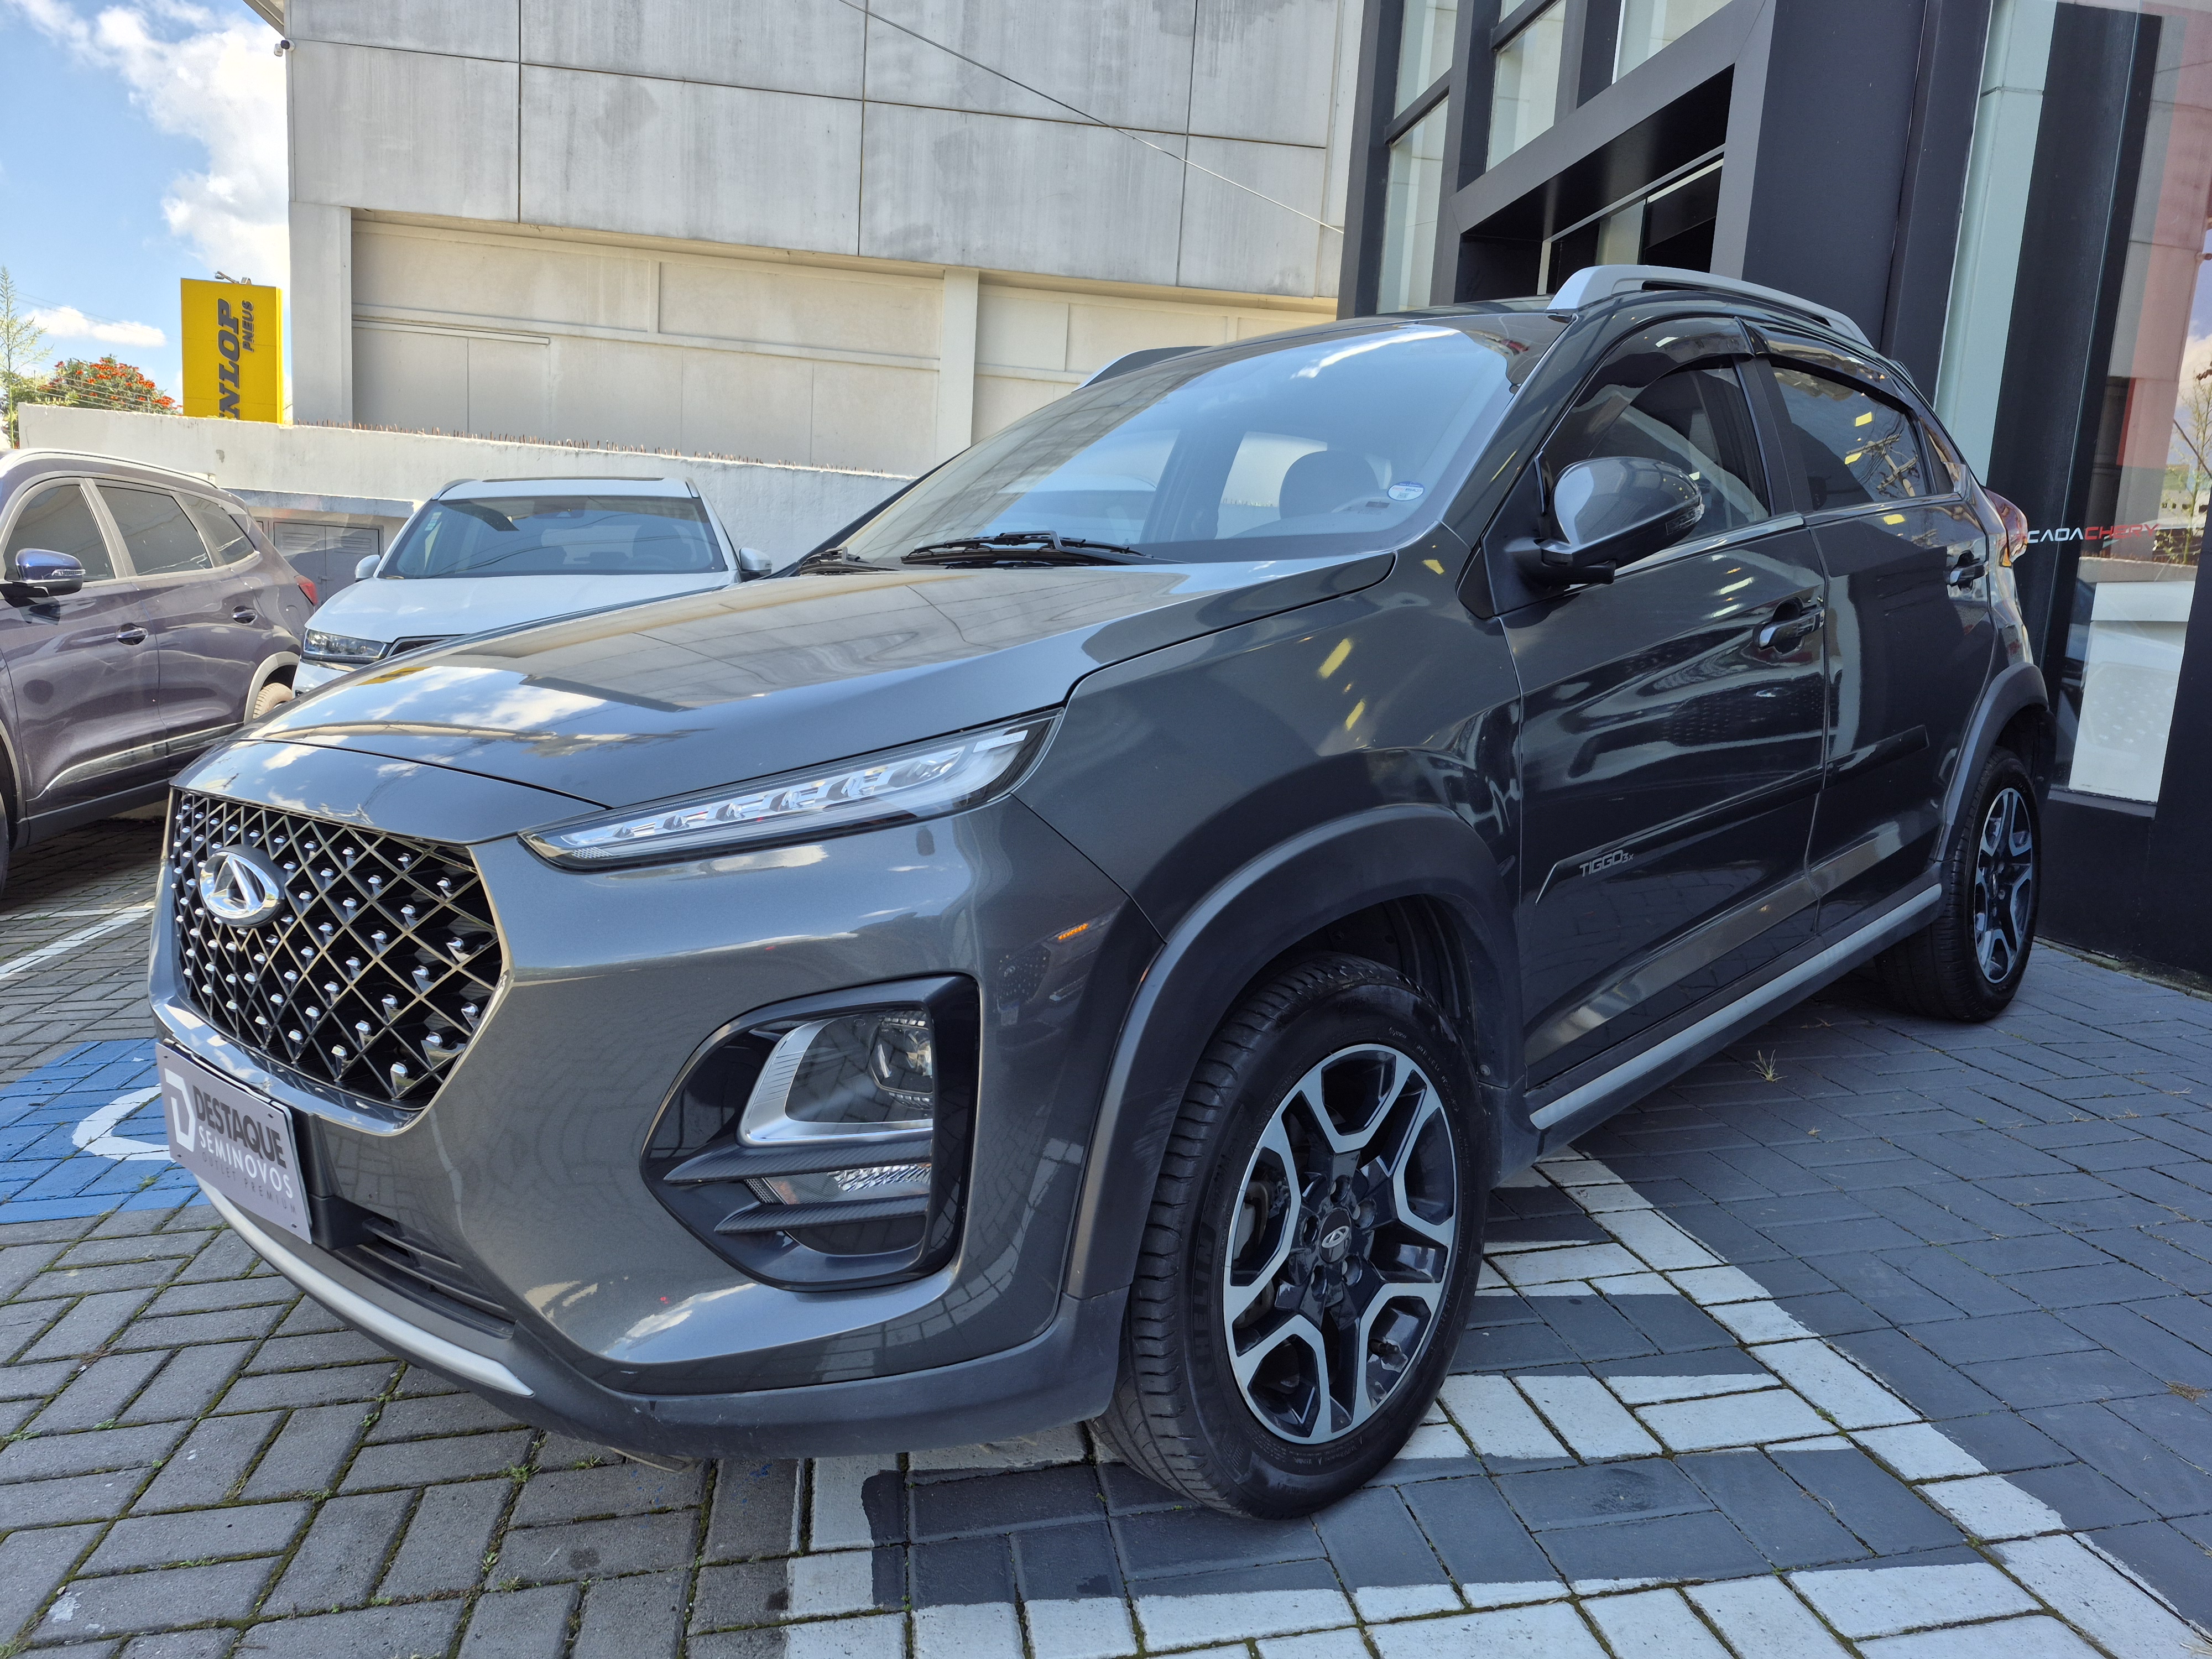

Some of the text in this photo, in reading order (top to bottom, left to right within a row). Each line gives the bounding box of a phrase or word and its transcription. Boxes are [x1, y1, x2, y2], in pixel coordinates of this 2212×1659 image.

[218, 298, 240, 420] NLOP
[242, 300, 254, 352] PNEUS
[192, 1084, 286, 1169] DESTAQUE
[199, 1125, 293, 1198] SEMINOVOS
[202, 1152, 297, 1214] OUTLET PREMIUM
